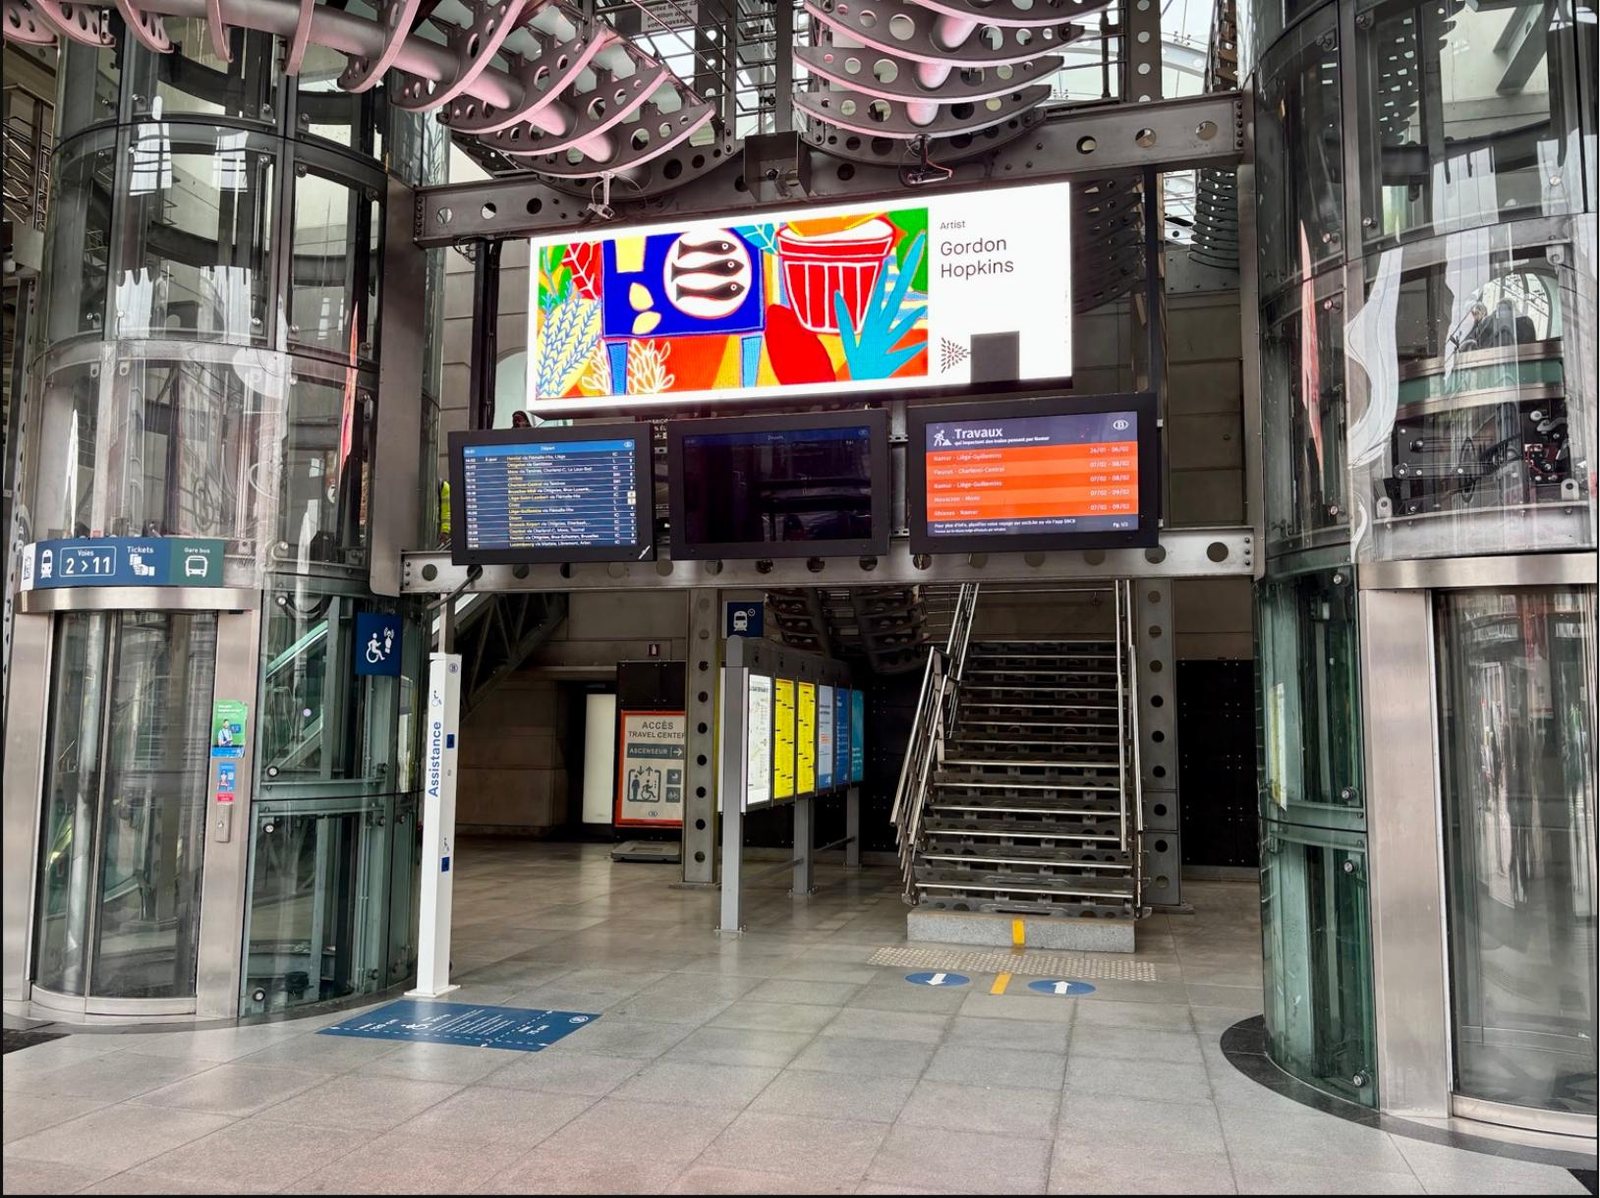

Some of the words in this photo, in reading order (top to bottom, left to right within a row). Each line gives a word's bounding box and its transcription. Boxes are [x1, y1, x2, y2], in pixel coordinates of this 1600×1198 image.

[940, 220, 966, 230] Artist
[940, 238, 1007, 257] Gordon
[941, 259, 1015, 281] Hopkins
[954, 428, 1003, 439] Travaux
[127, 546, 155, 554] Tickets
[66, 558, 75, 574] 2
[92, 556, 111, 574] 11
[642, 721, 674, 730] ACCÈS
[629, 747, 669, 755] ASCENSEUR
[428, 721, 442, 798] Assistance
